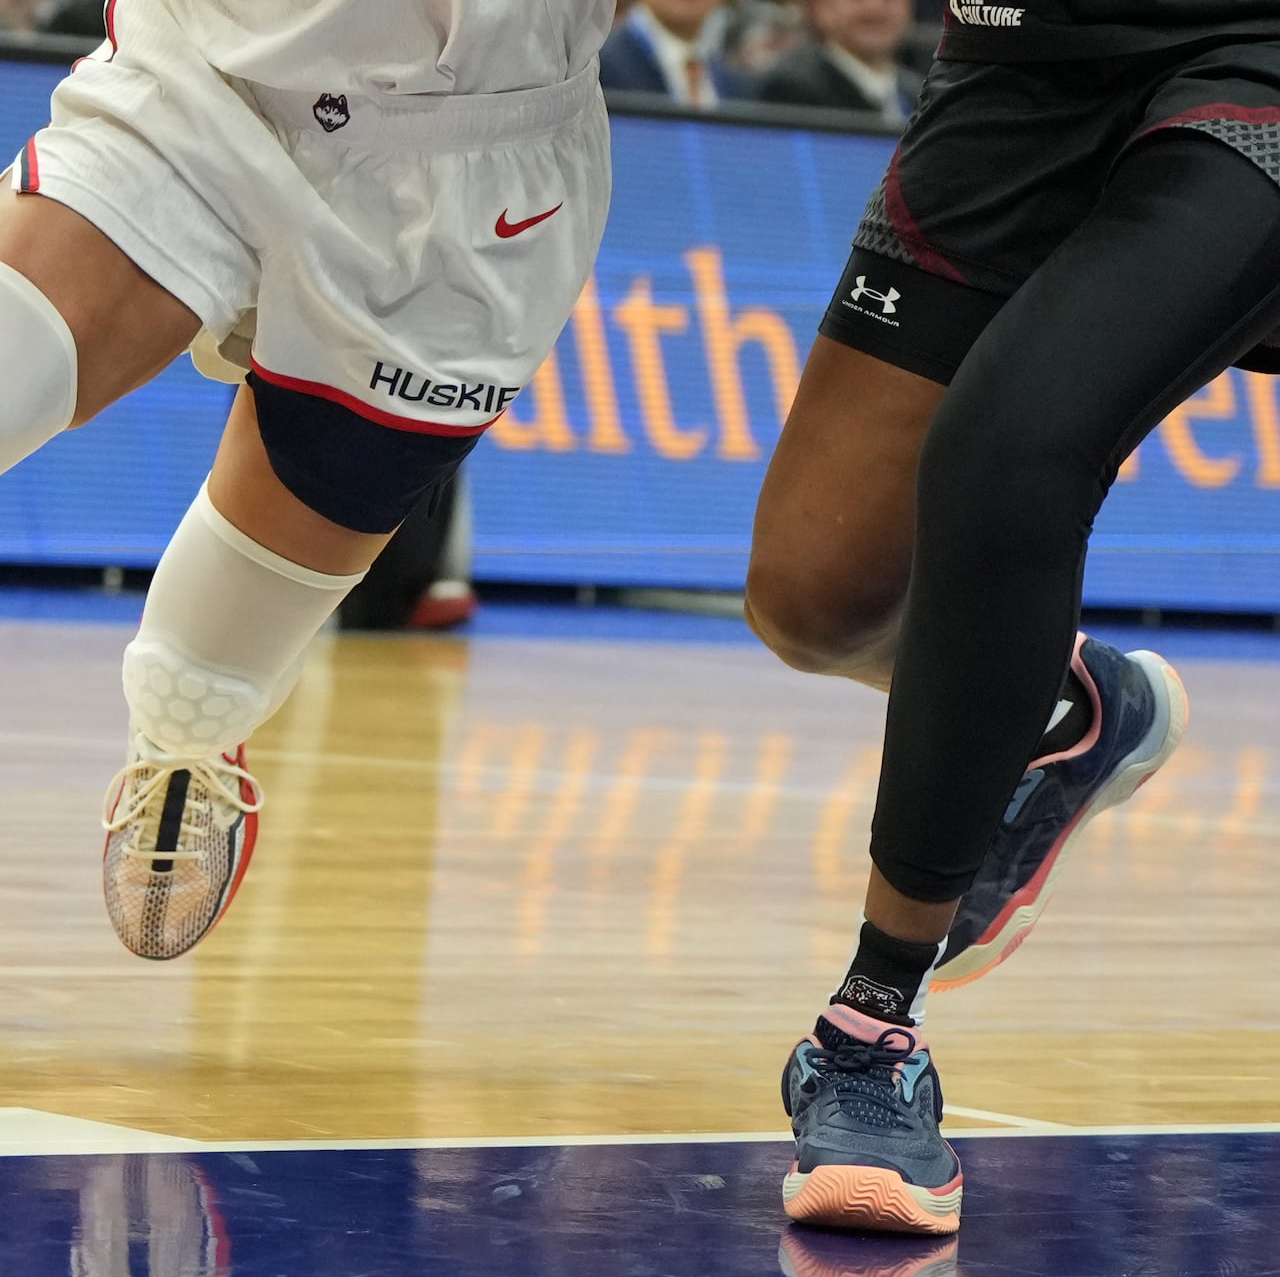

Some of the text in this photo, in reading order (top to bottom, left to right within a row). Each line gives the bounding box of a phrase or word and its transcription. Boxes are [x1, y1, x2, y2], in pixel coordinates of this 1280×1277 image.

[961, 5, 1026, 27] CULTURE
[841, 299, 900, 327] UNDER ARMOUR
